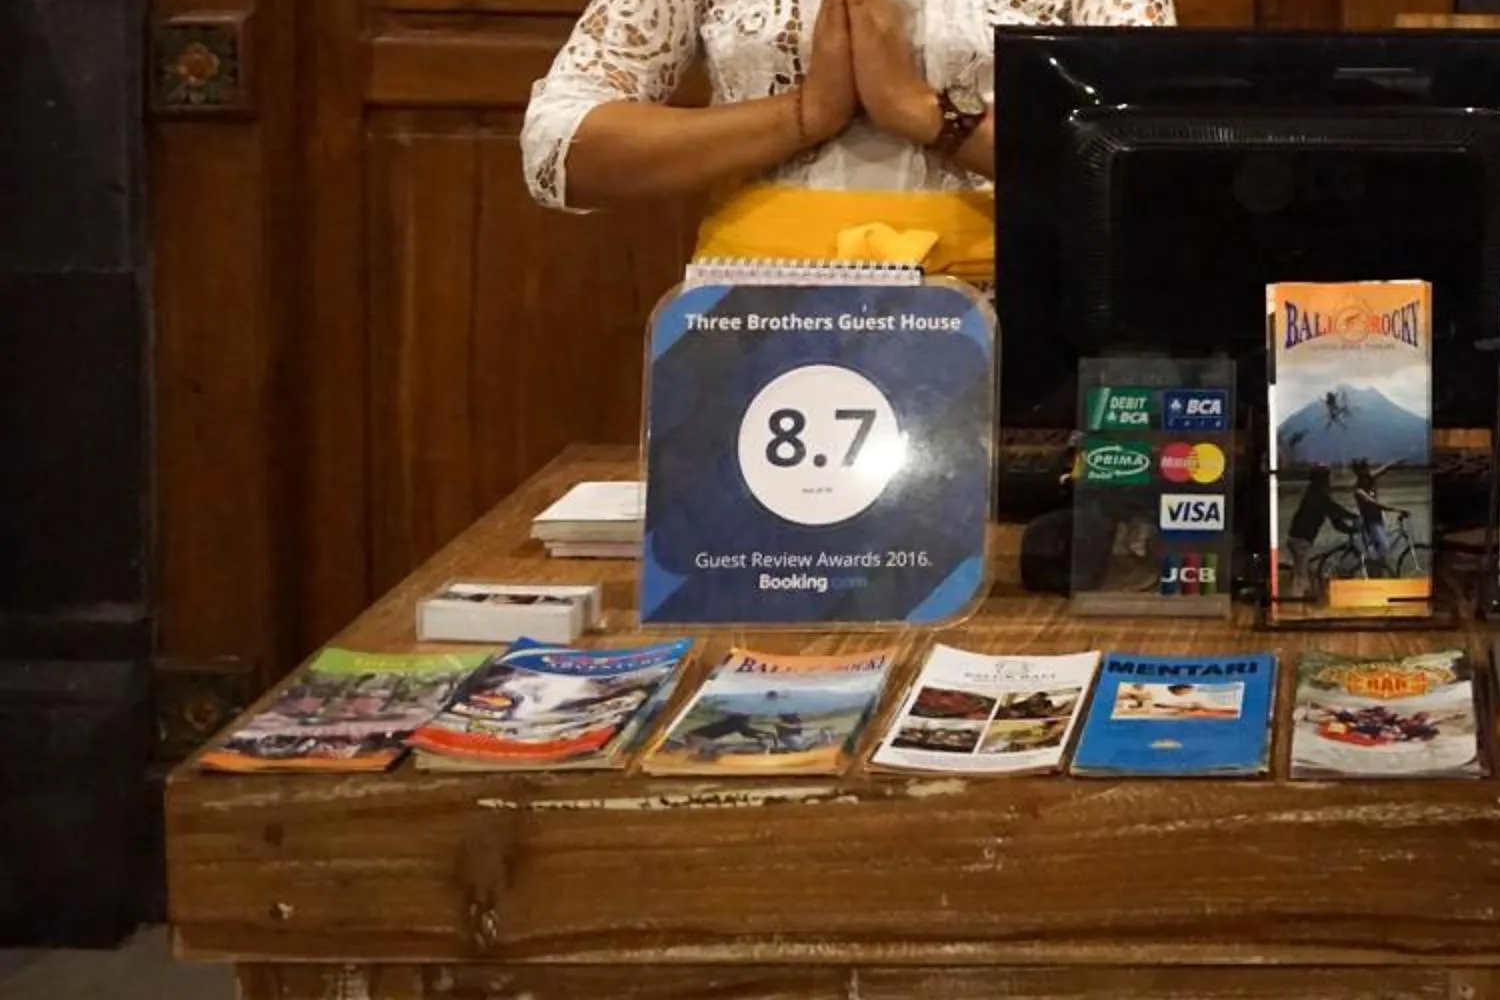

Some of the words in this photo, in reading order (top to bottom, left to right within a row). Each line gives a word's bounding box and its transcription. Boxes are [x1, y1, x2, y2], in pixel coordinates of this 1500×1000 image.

[684, 313, 743, 331] Three
[747, 313, 834, 331] Brothers
[838, 313, 895, 331] Guest
[900, 313, 962, 331] House
[1109, 396, 1148, 410] DEBIT
[1186, 398, 1223, 416] BCA
[1119, 411, 1150, 424] BCA
[764, 408, 878, 469] 8.7
[1094, 455, 1144, 466] PRIMA
[1167, 501, 1221, 523] VISA
[694, 551, 747, 569] Guest
[751, 551, 814, 568] Review
[816, 551, 881, 568] Awards
[1161, 567, 1217, 583] JCB
[1107, 660, 1260, 677] MENTARI
